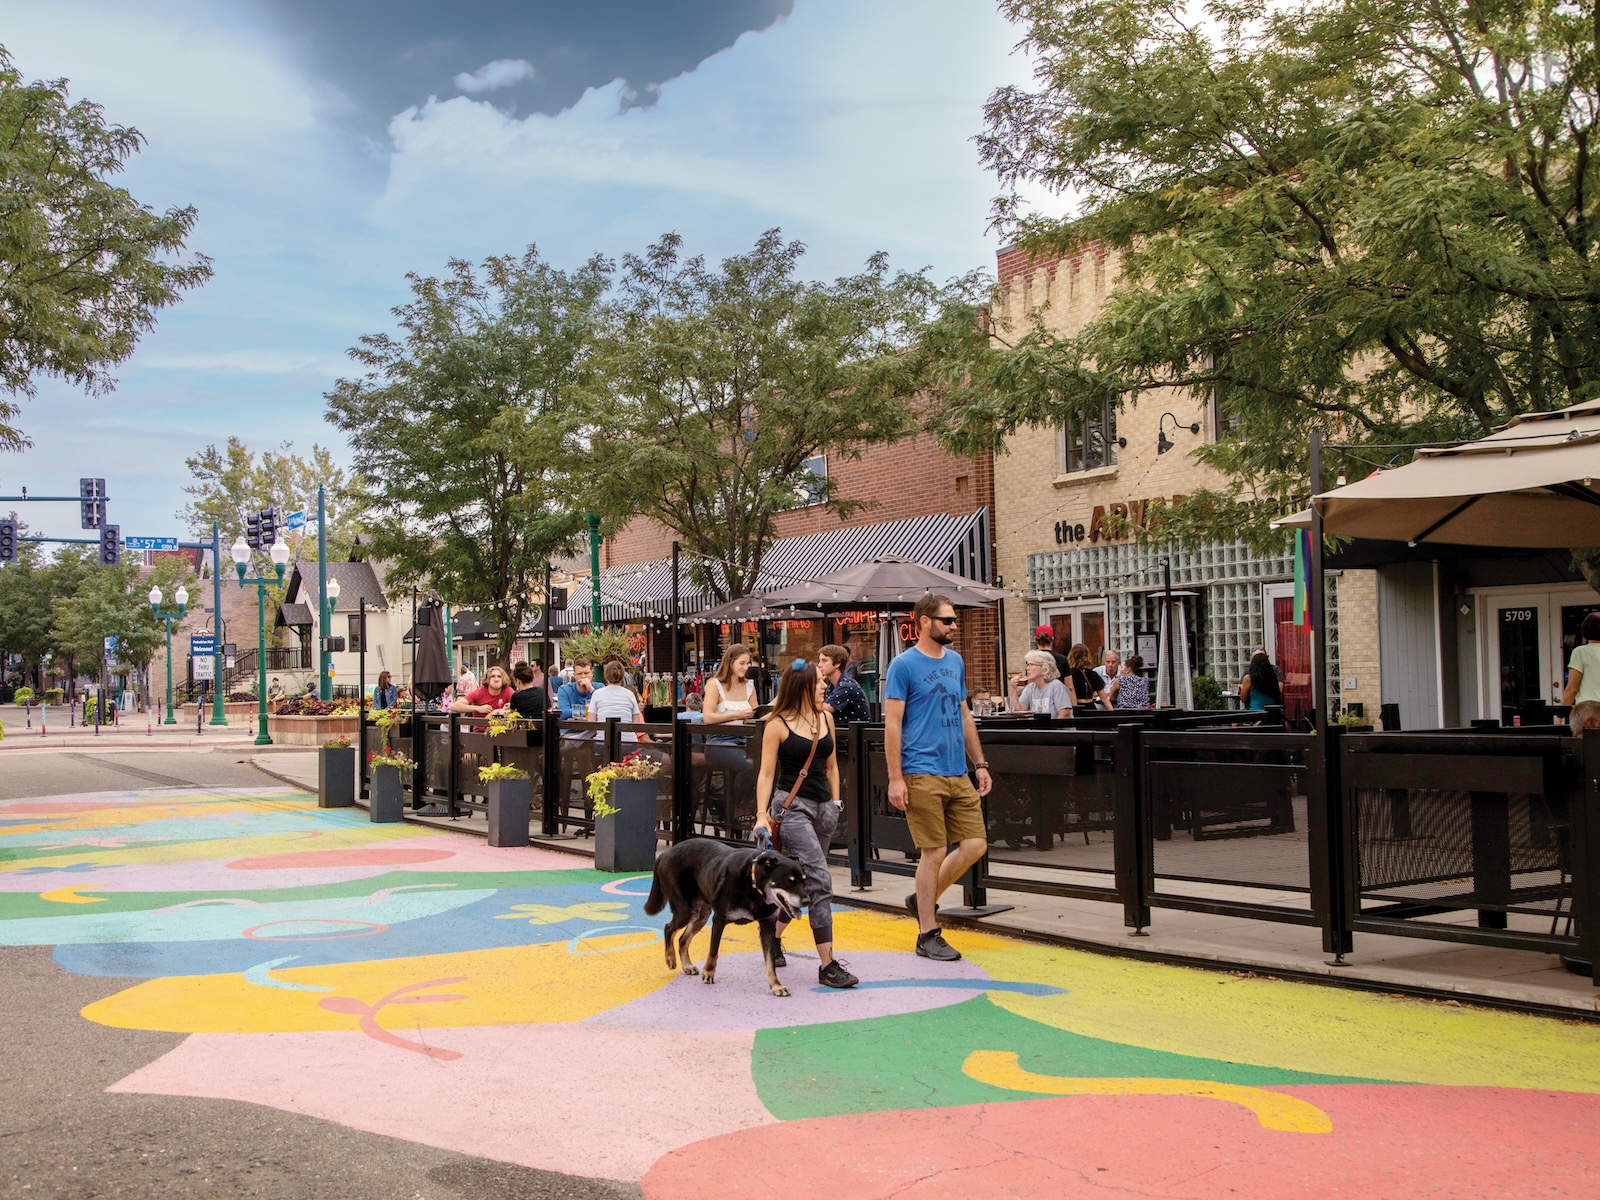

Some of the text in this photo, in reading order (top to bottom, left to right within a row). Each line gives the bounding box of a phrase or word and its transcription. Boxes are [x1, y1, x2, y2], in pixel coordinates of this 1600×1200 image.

[1055, 520, 1085, 544] the
[145, 539, 156, 549] 57
[1505, 610, 1532, 622] 5709
[923, 668, 961, 685] THE GREA
